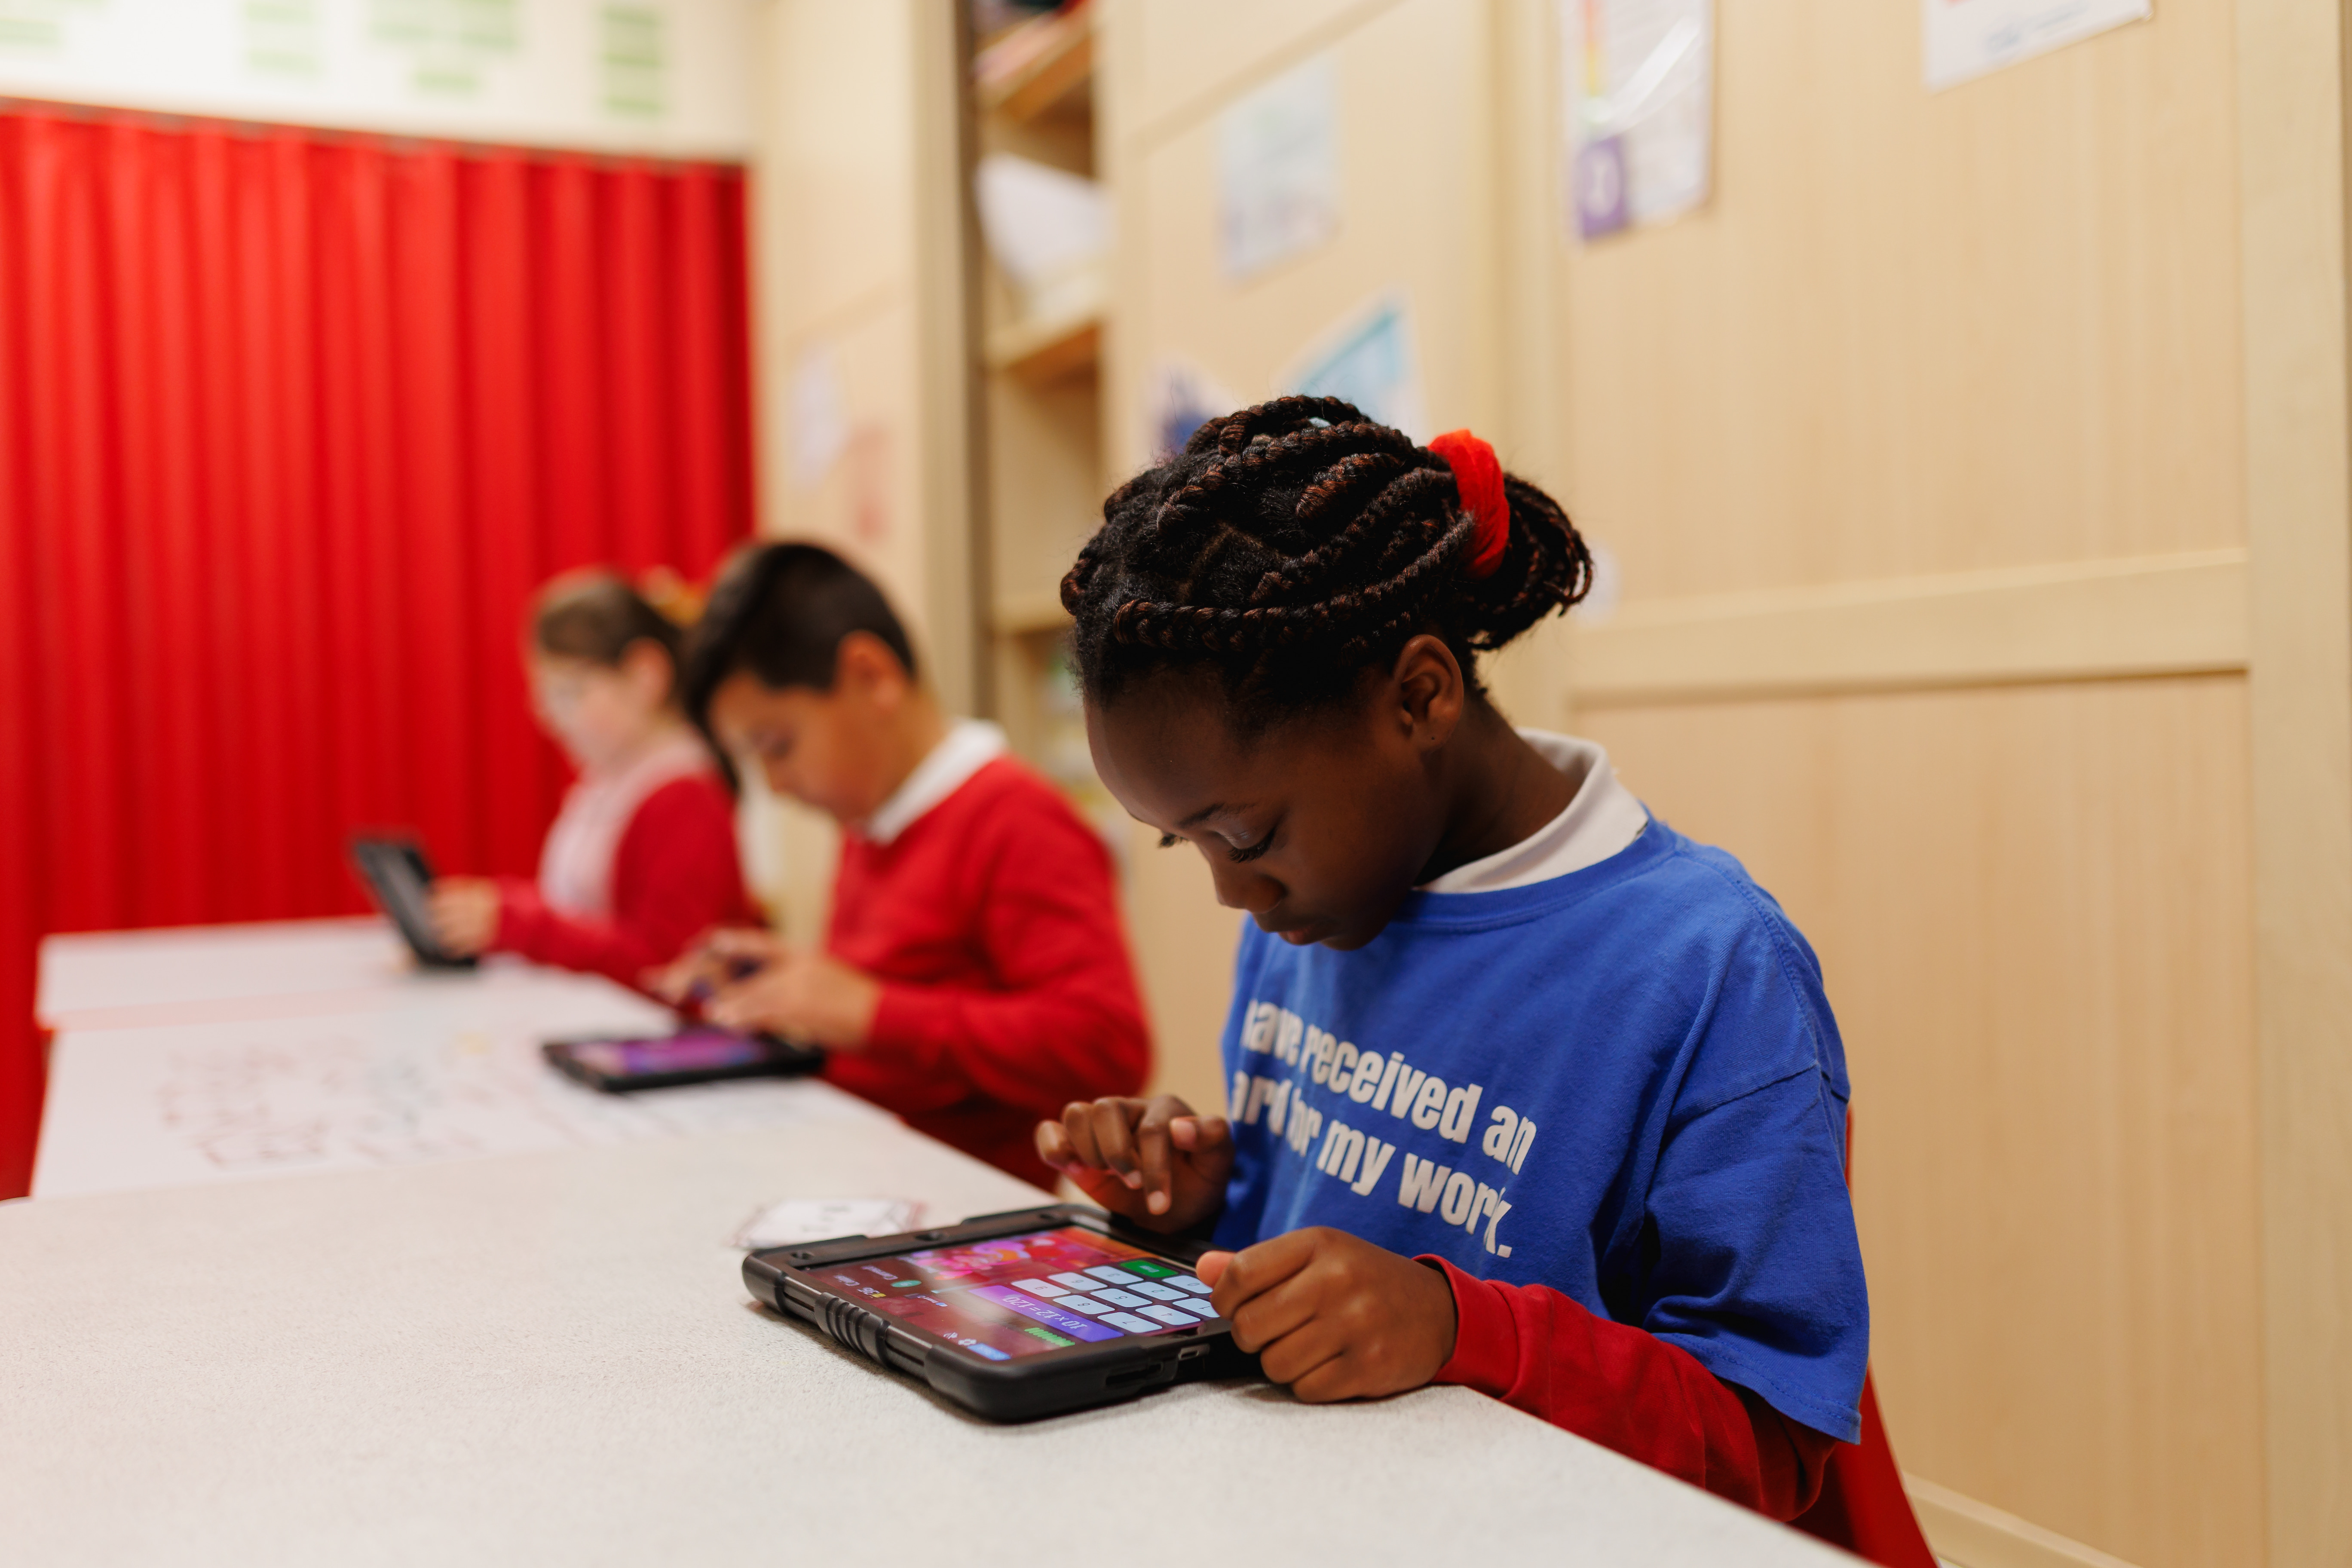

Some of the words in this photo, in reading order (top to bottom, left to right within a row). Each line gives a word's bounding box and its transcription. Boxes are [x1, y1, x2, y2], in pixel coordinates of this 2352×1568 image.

[1240, 998, 1304, 1067] ave
[1299, 1023, 1483, 1144] received
[1482, 1105, 1537, 1176] an
[1231, 1070, 1293, 1136] ard
[1316, 1119, 1396, 1196] my
[1002, 1297, 1035, 1308] 120
[1035, 1310, 1061, 1318] 12
[1061, 1320, 1088, 1329] 10
